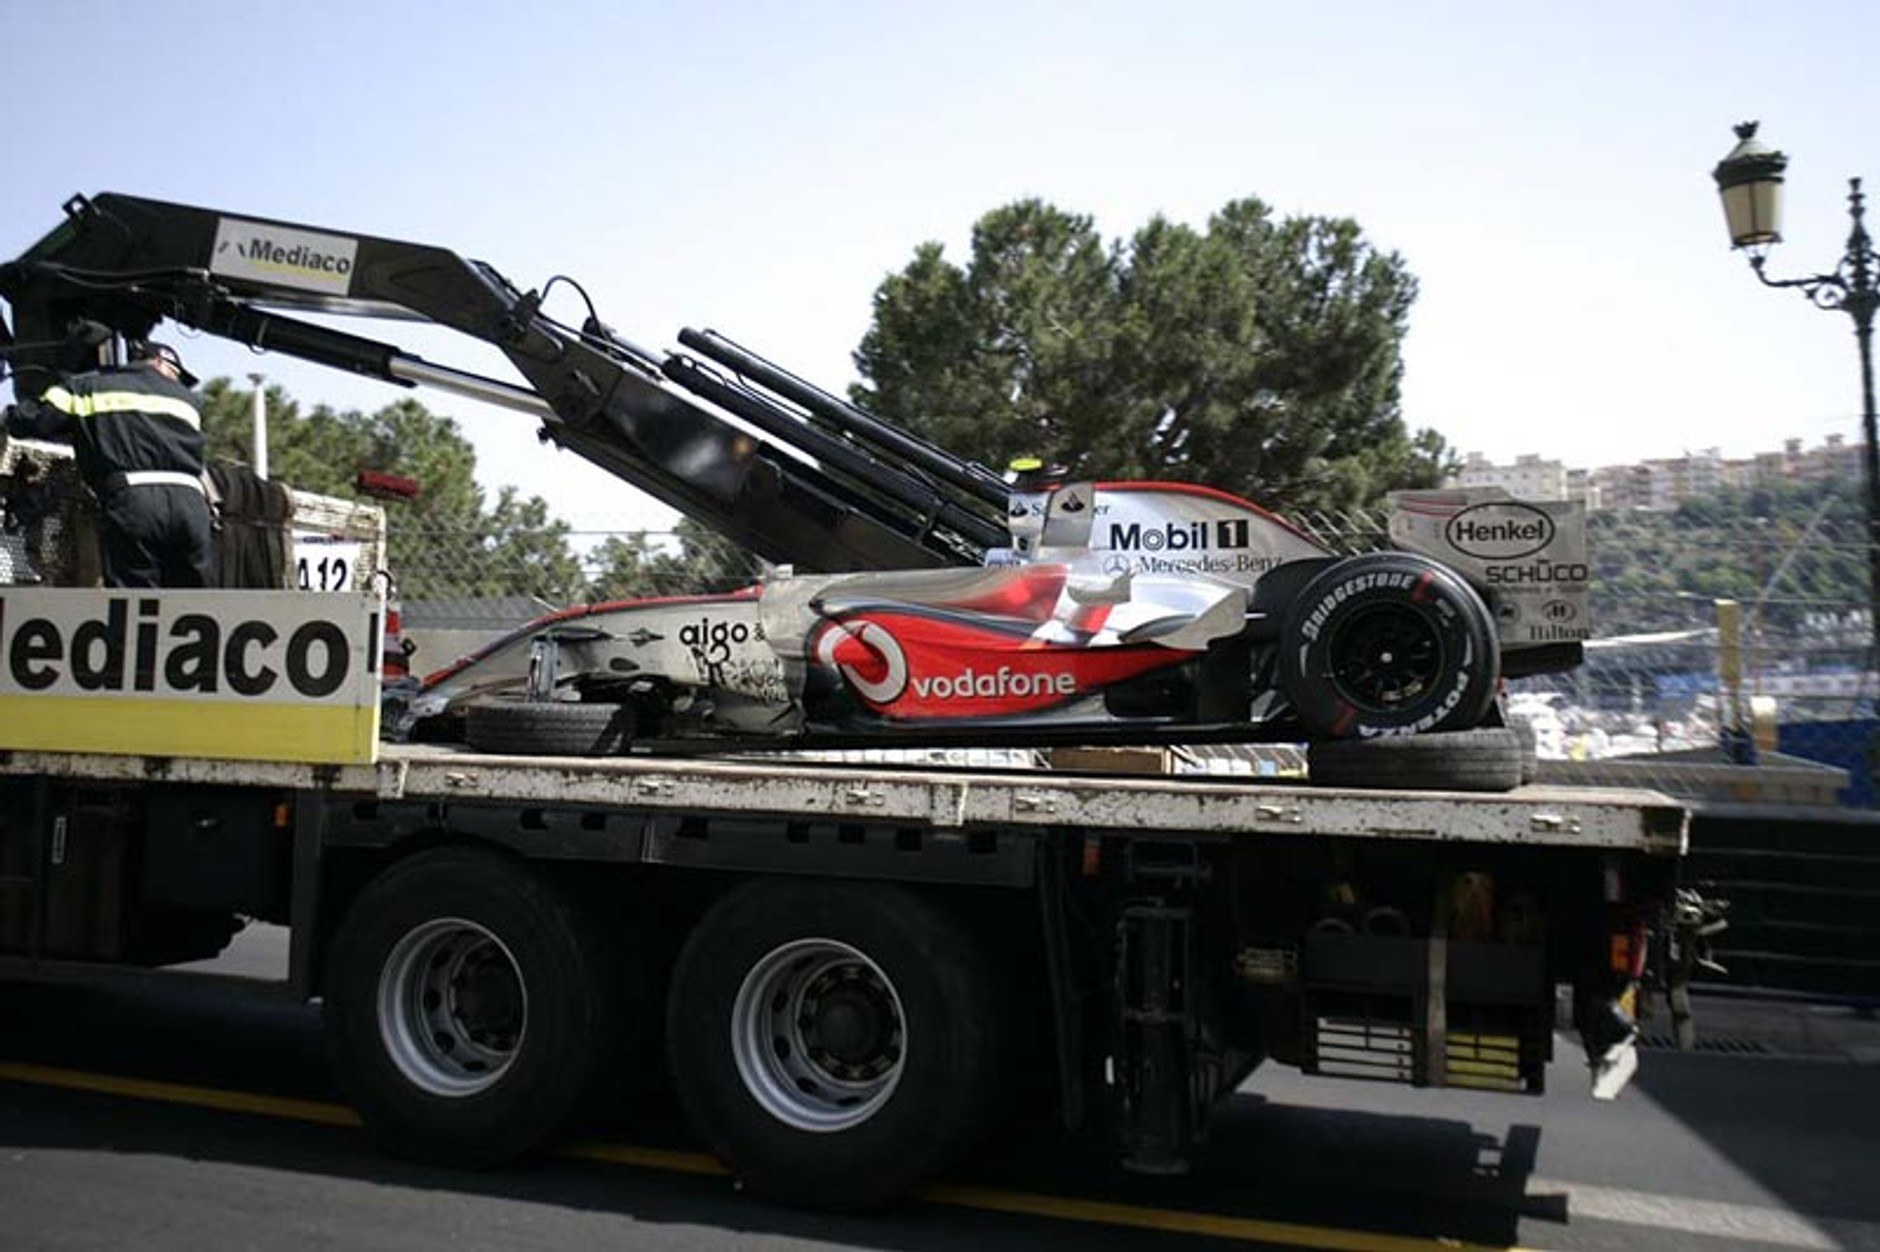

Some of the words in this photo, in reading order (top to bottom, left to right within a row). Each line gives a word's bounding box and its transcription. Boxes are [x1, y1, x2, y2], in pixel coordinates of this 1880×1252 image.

[250, 238, 351, 274] Mediaco
[1109, 522, 1208, 551] Mobil
[1456, 519, 1545, 542] Henkel
[1301, 572, 1415, 641] BRIDGESTONE
[0, 598, 350, 697] ediaco
[680, 617, 749, 664] aigo
[911, 666, 1076, 698] vodafone
